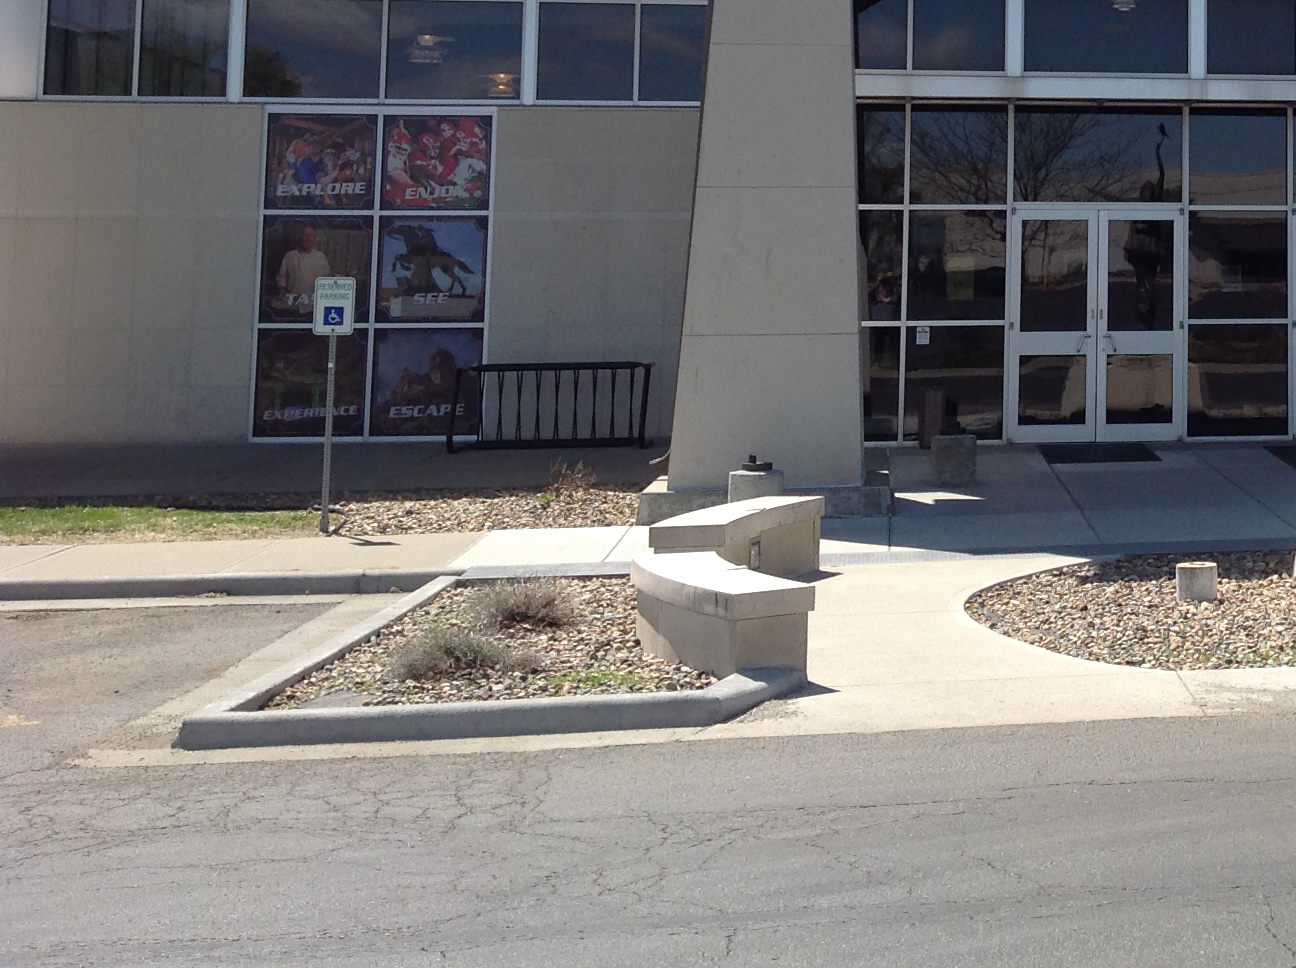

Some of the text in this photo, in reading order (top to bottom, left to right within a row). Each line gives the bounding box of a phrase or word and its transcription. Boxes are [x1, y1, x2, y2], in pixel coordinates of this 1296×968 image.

[275, 182, 367, 197] EXPLORE
[412, 292, 450, 305] SEE
[388, 403, 466, 419] ESCAPE
